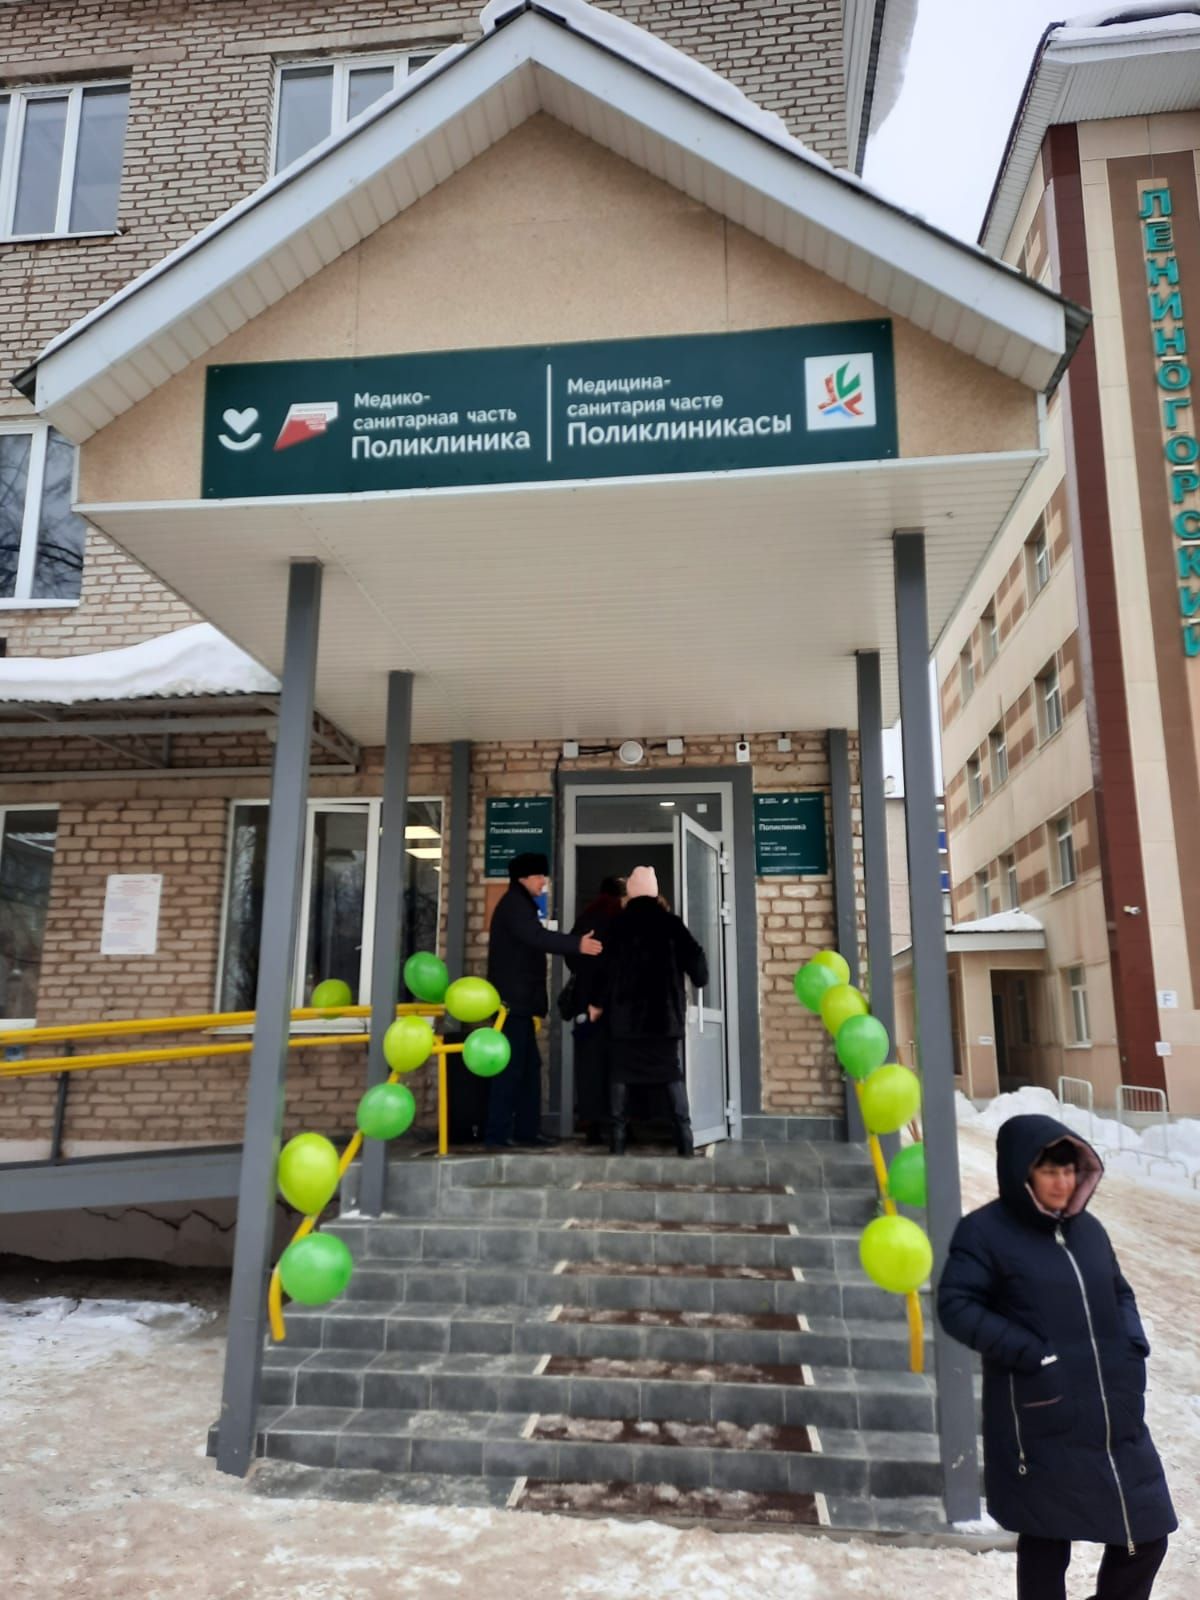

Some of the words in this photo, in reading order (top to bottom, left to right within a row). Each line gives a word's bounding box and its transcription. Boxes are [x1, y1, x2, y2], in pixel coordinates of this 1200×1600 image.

[567, 374, 671, 397] Медицина-
[354, 391, 430, 408] Медико-
[567, 397, 666, 419] санитария
[669, 393, 723, 410] часте
[353, 411, 458, 433] санитарная
[466, 406, 517, 424] часть
[567, 414, 792, 447] Поликлиникасы
[351, 429, 531, 460] Поликлиника
